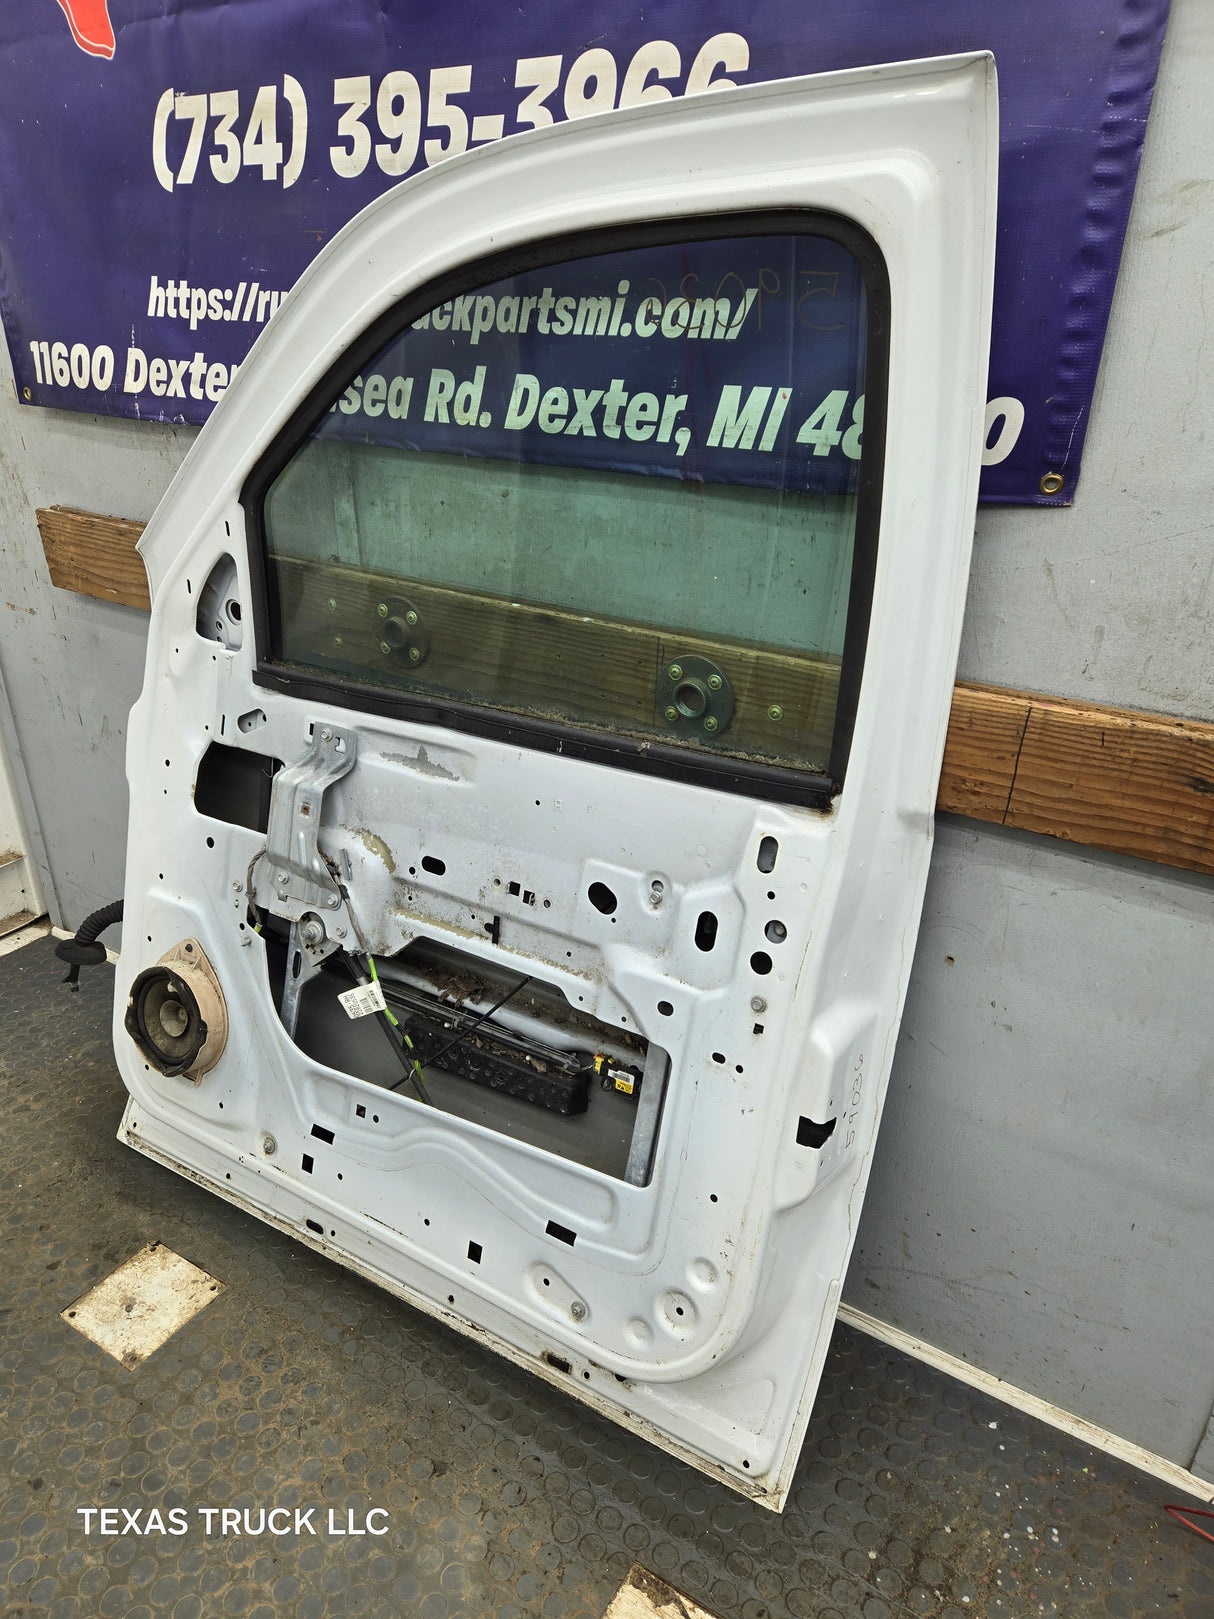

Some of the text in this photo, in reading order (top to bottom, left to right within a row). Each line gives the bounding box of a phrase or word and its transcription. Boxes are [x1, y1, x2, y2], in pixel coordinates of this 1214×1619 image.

[153, 73, 308, 193] (734)
[30, 340, 115, 392] 11600
[329, 373, 414, 420] sea
[424, 365, 492, 428] Rd.
[504, 373, 692, 457] Dexter,
[705, 384, 793, 452] MI
[845, 1054, 864, 1149] 59036
